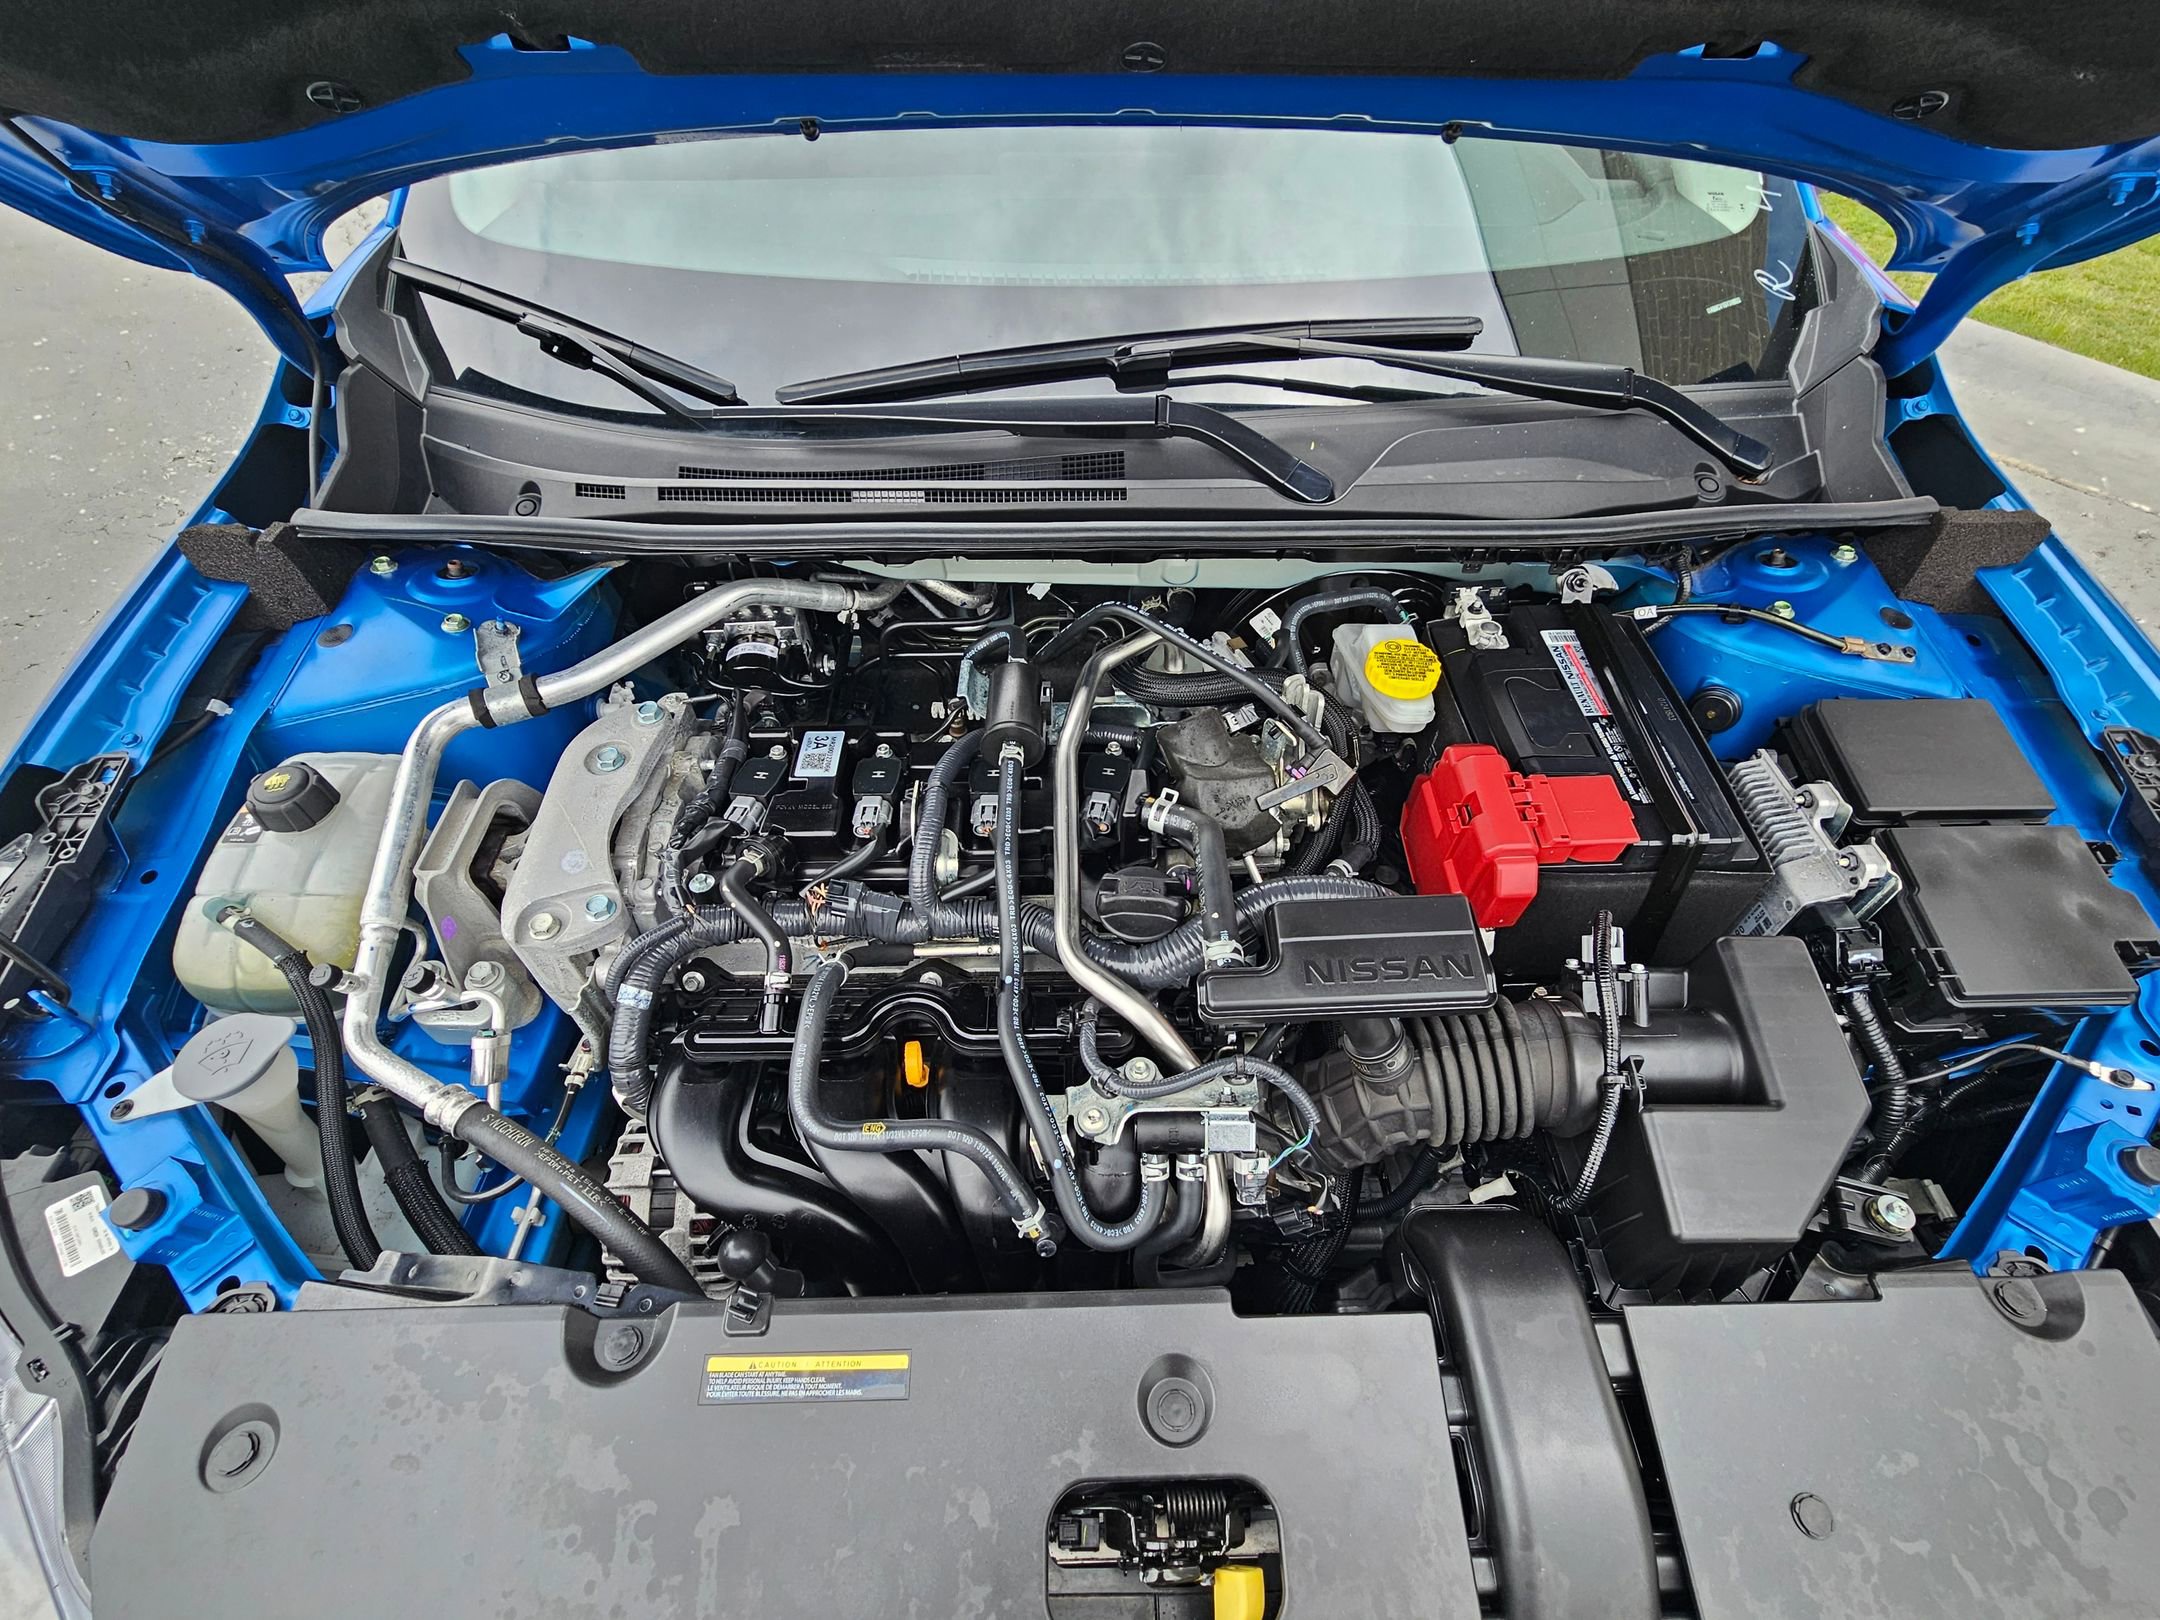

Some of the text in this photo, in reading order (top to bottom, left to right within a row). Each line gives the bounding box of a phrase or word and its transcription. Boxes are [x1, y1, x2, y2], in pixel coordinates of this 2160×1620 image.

[1551, 645, 1576, 680] NISSAN
[1570, 682, 1594, 714] RENAULT
[812, 736, 830, 750] 3A
[1303, 954, 1475, 986] NISSAN
[758, 1361, 797, 1370] CAUTION
[815, 1360, 862, 1368] ATTENTION
